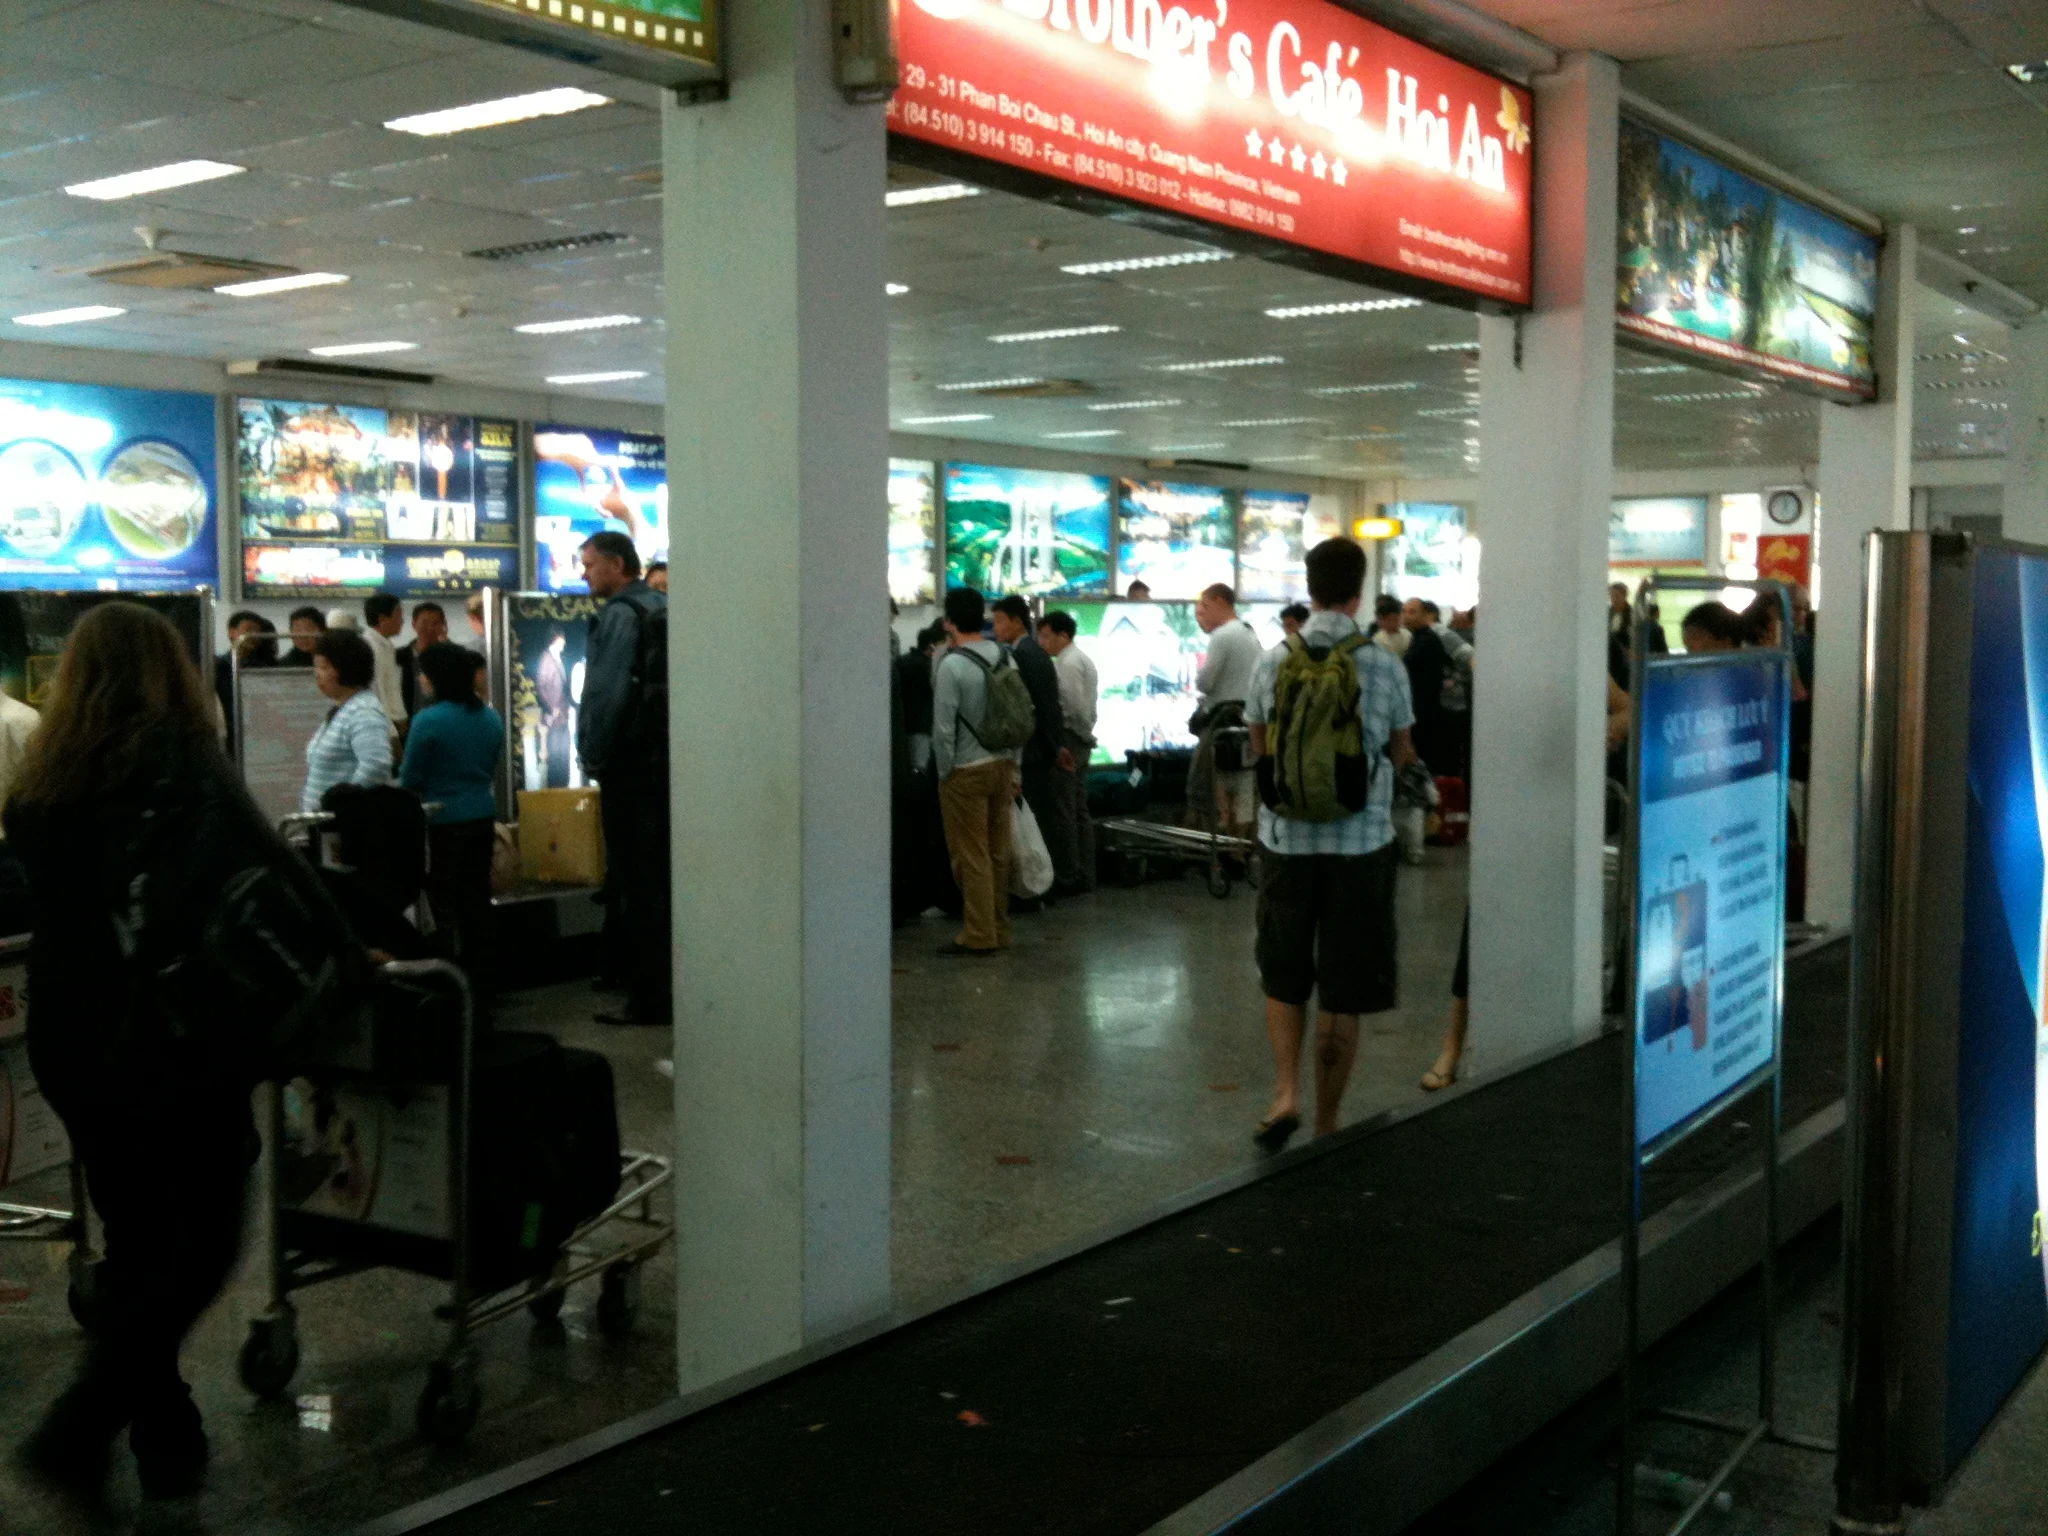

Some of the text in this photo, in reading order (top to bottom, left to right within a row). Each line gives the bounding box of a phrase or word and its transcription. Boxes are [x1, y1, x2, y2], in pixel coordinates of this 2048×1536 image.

[906, 63, 926, 90] 29
[938, 73, 956, 98] 31
[959, 80, 997, 112] Phan
[998, 93, 1021, 120] Boi
[1022, 101, 1059, 132] Chau
[1083, 121, 1105, 147] Hoi
[966, 118, 978, 142] 3
[978, 121, 1006, 150] 914
[1008, 133, 1034, 159] 150
[1266, 20, 1364, 142] Café
[1385, 67, 1451, 174] Hoi
[1456, 102, 1506, 192] An
